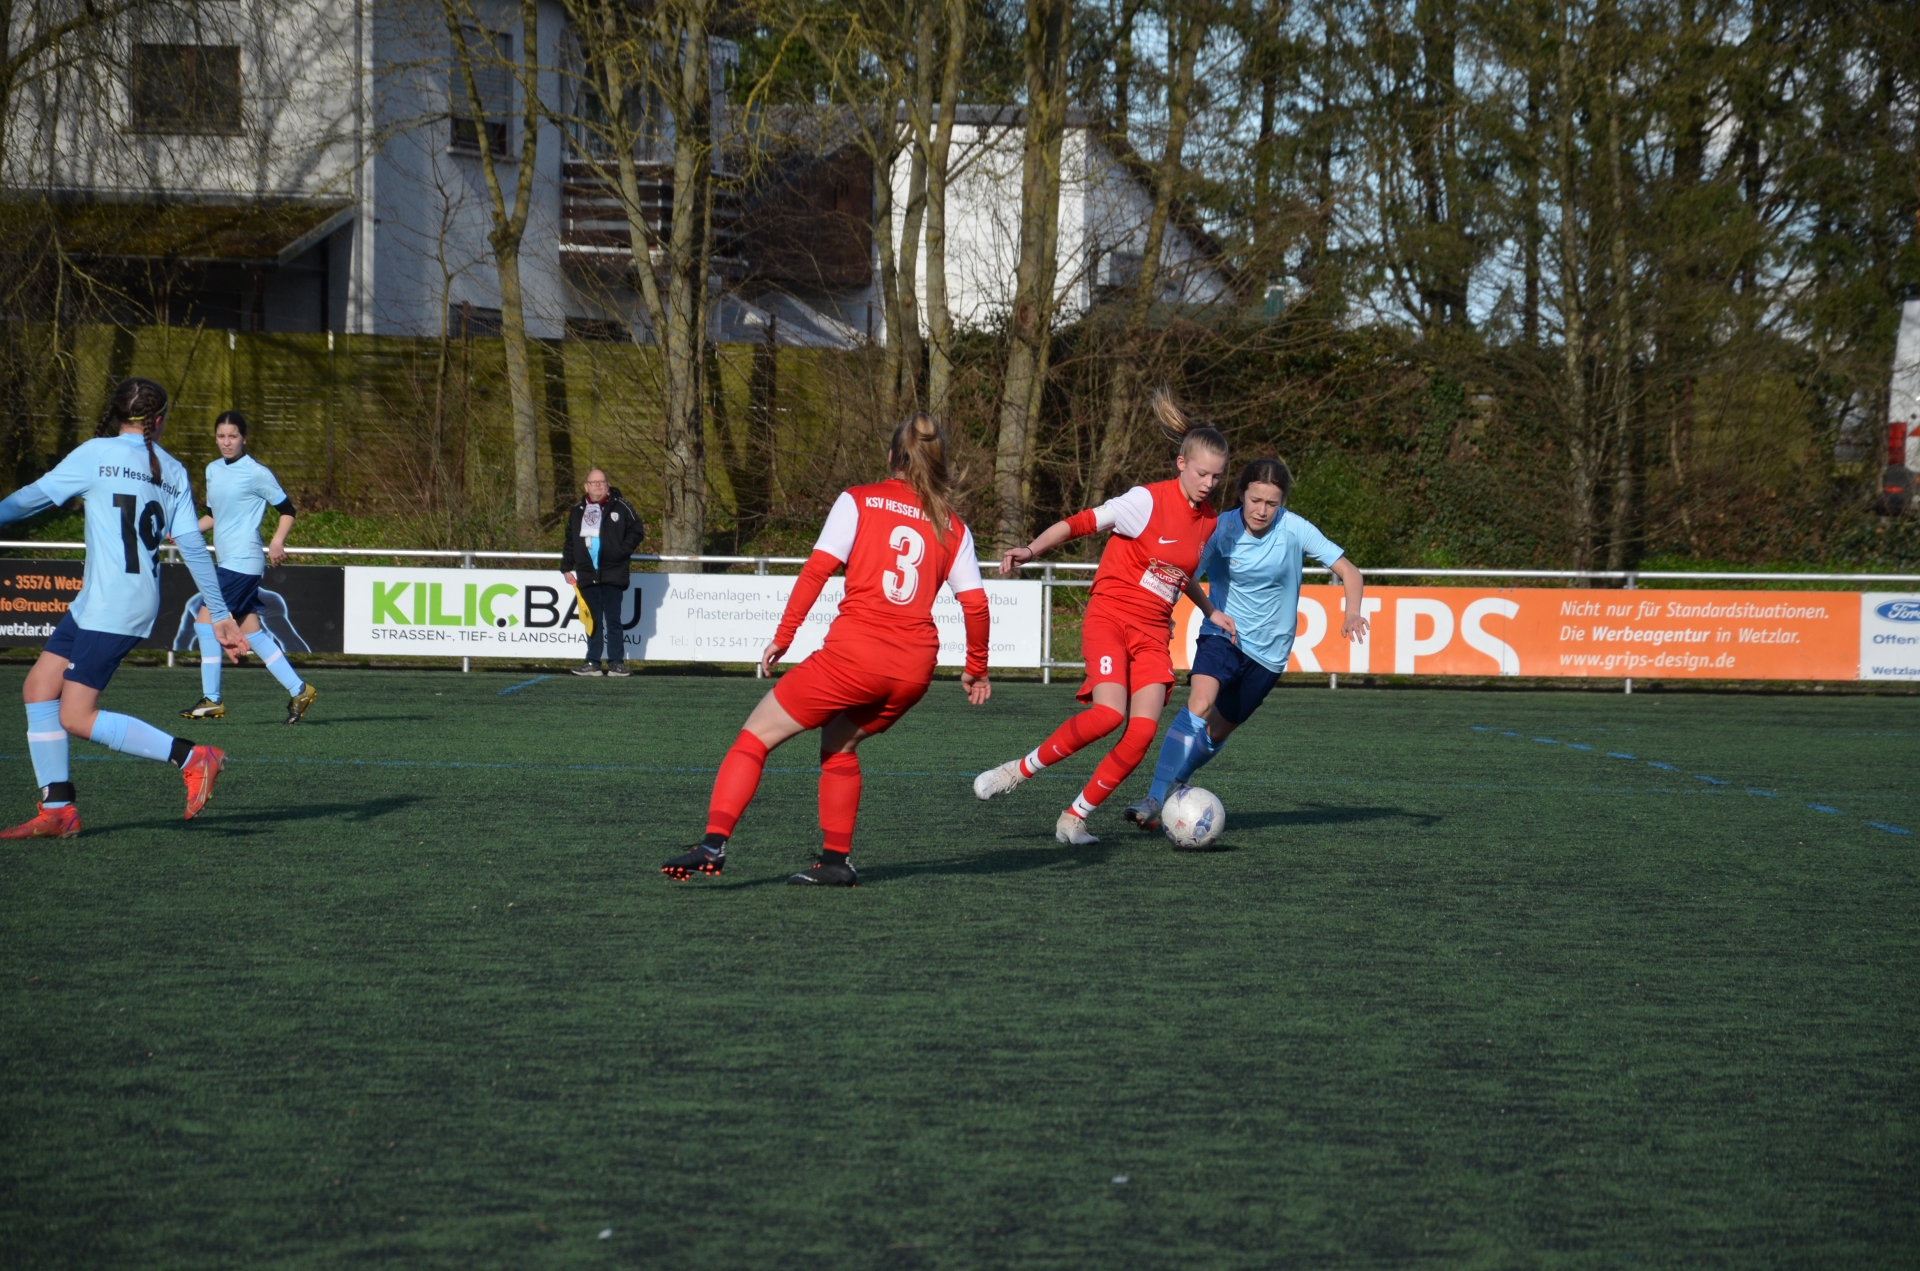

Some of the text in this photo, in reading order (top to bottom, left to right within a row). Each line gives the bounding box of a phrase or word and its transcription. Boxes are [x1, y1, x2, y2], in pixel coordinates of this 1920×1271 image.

[99, 466, 120, 477] FSV
[123, 467, 152, 483] Hesse
[865, 496, 920, 519] KSV HESSEN
[882, 525, 925, 605] 3
[15, 575, 84, 591] 35576 Wetz
[670, 588, 761, 604] Außenanlagen
[687, 607, 784, 621] Pflasterarbeiten
[1560, 600, 1829, 621] Nicht nur für Standardsituationen.
[1887, 602, 1920, 619] For
[458, 631, 494, 641] TIEF-
[497, 632, 507, 642] &
[695, 636, 703, 647] 0
[706, 637, 726, 647] 152
[729, 638, 748, 647] 541
[1560, 625, 1801, 646] Die Werbeagentur in Wetzlar.
[1872, 634, 1920, 645] Offen
[1100, 655, 1112, 675] 8
[1559, 650, 1736, 671] www.grips-design.de
